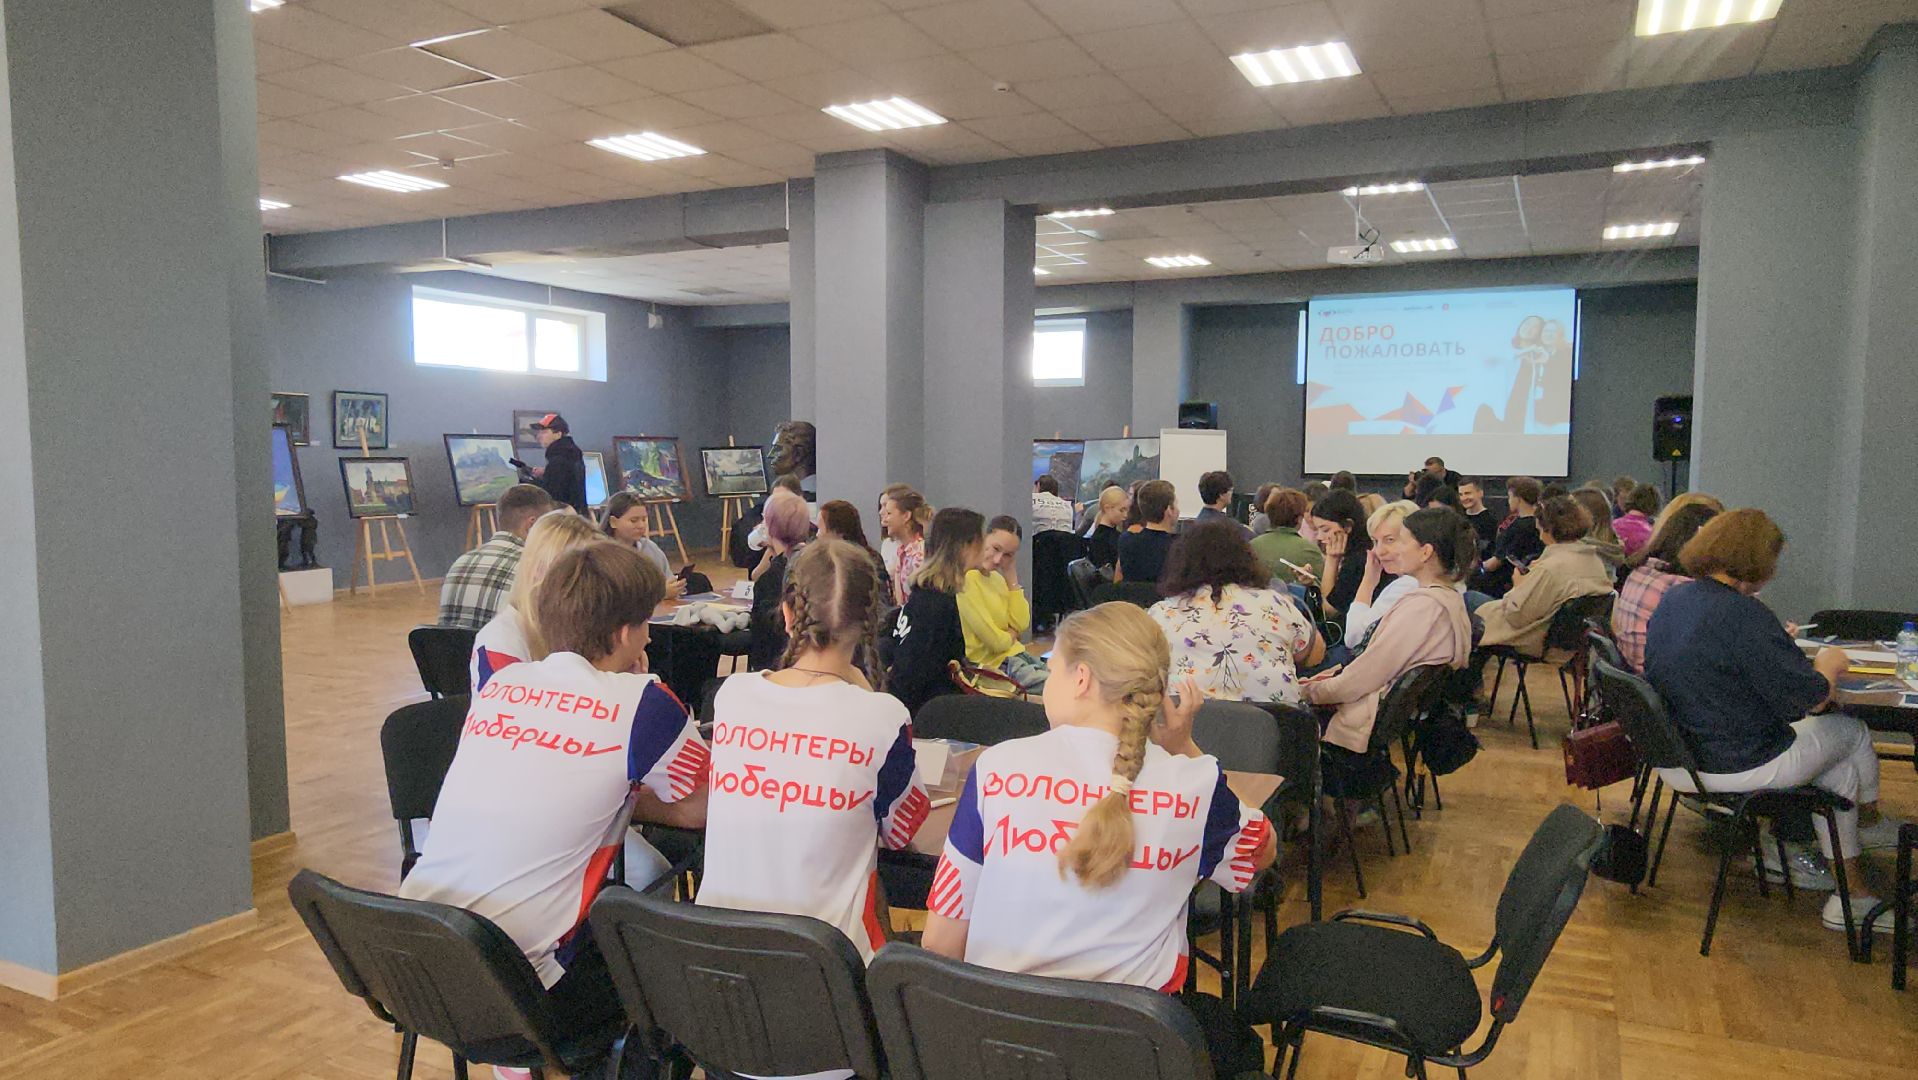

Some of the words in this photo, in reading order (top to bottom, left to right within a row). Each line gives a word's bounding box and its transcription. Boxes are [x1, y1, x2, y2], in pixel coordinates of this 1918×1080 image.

[1319, 324, 1395, 346] ДОБРО
[1324, 341, 1466, 360] ПОЖАЛОВАТЬ
[481, 681, 621, 722] ОЛОНТЕРЫ
[714, 722, 875, 767] ОЛОНТЕРЫ
[983, 771, 1200, 819] ВОЛОНЕРЫ
[984, 814, 1200, 871] Любцы
